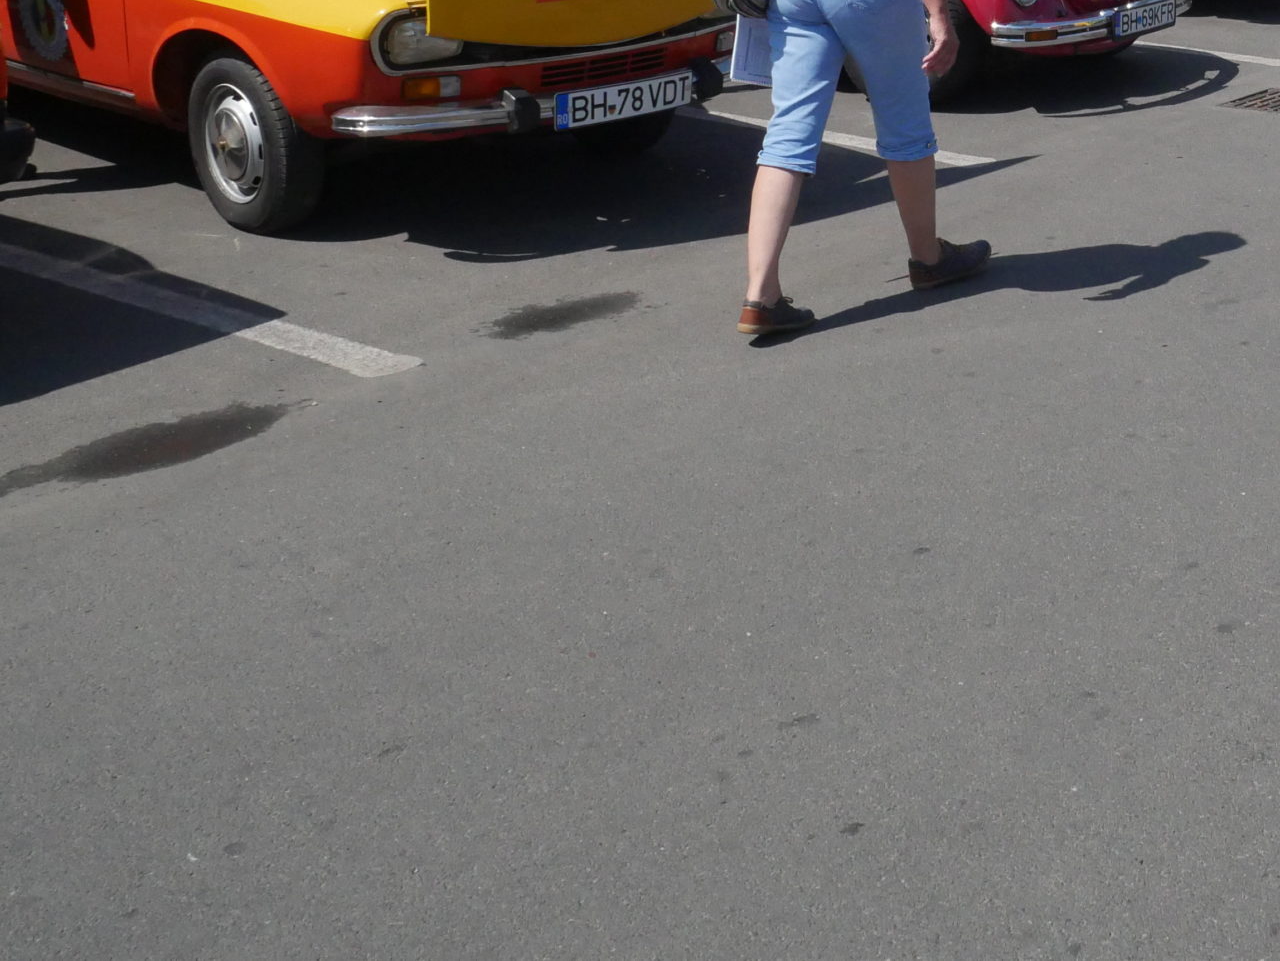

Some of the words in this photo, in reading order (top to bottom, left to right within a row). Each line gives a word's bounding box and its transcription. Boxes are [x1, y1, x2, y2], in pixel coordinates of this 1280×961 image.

[1121, 10, 1138, 33] BH
[572, 91, 607, 123] BH
[649, 76, 689, 108] VDT
